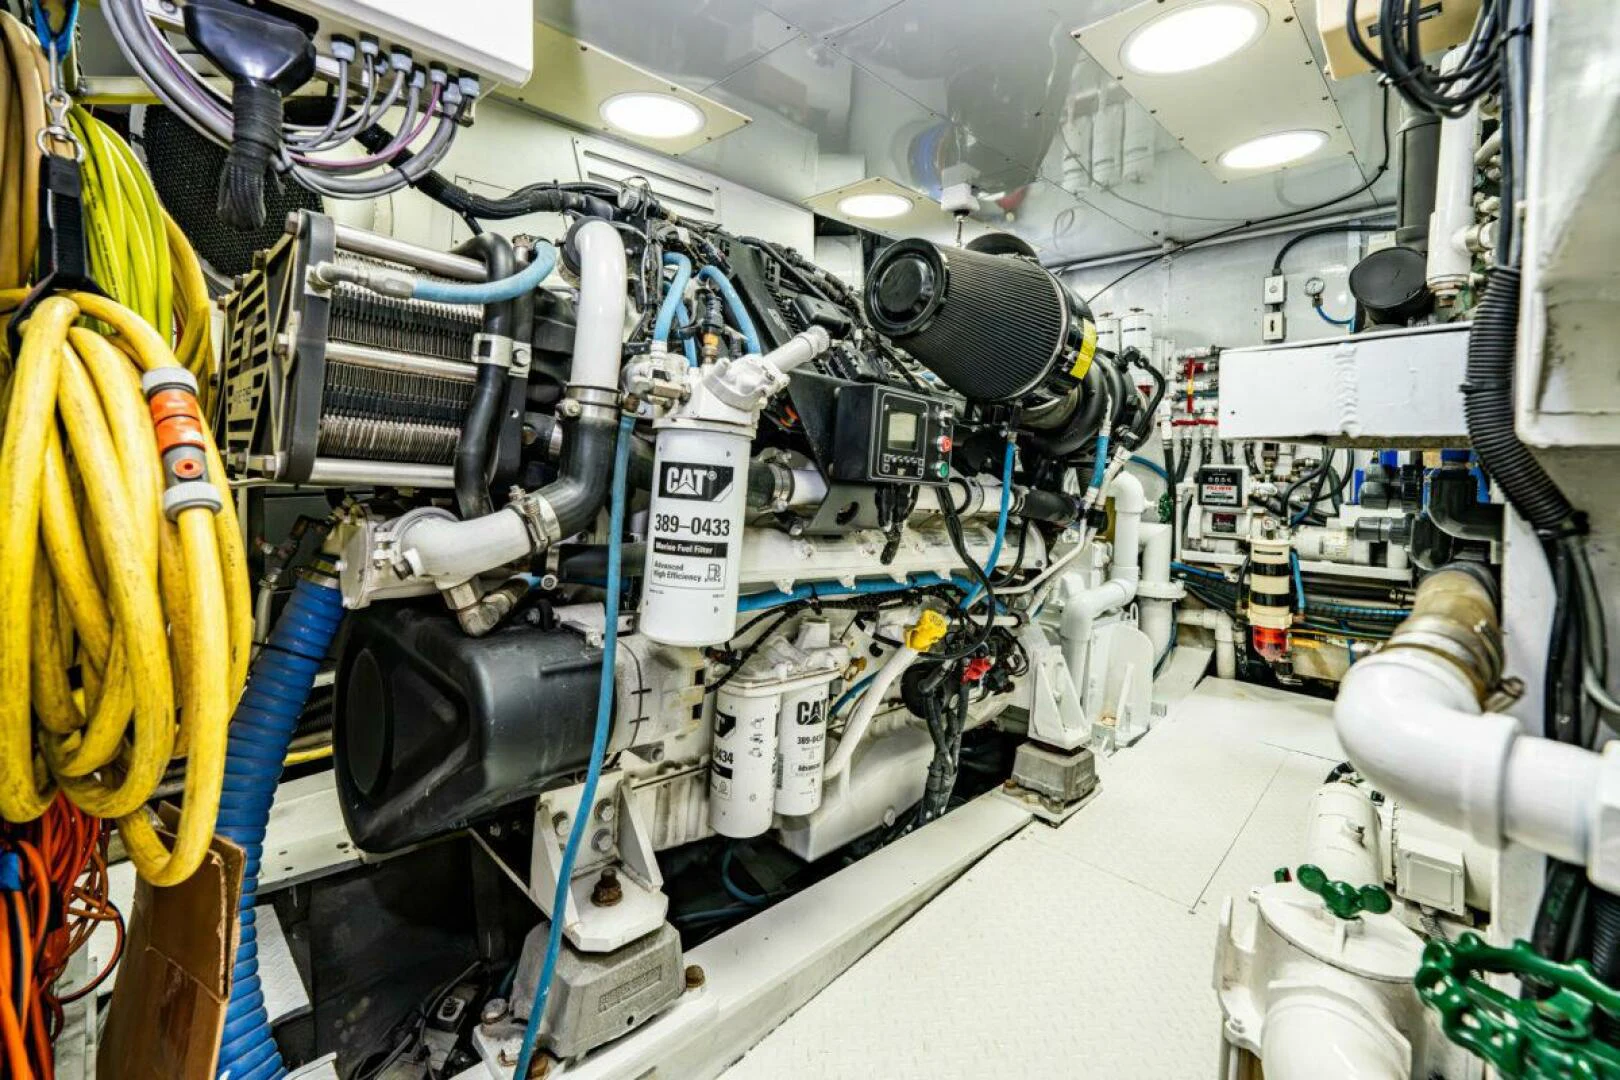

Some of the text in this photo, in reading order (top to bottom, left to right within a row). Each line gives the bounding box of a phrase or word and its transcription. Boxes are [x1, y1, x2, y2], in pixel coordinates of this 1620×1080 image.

[654, 513, 730, 536] 389-0433
[677, 543, 694, 553] Fuel
[694, 544, 714, 555] Filter
[654, 560, 684, 571] Advanced
[666, 571, 701, 582] Efficiency
[797, 699, 826, 725] CAT
